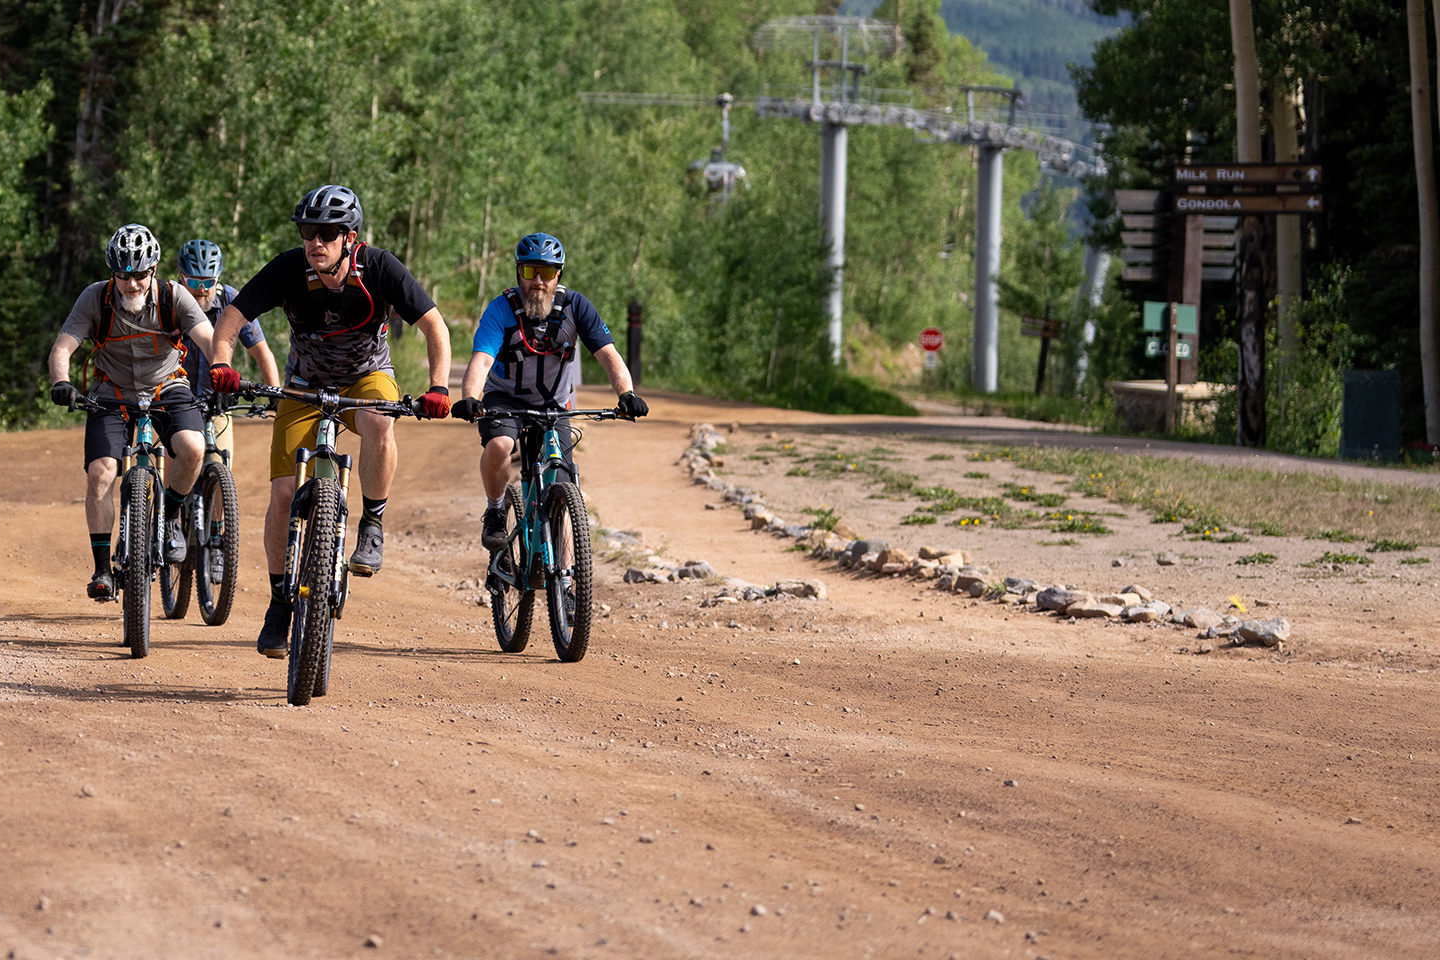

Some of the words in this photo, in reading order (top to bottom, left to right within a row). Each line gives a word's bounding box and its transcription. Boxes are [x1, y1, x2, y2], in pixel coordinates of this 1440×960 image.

[1176, 169, 1208, 180] MILK
[1216, 169, 1245, 180] RUN
[1176, 198, 1242, 210] GONDOLA
[921, 335, 942, 346] STOP
[285, 544, 295, 575] FOX
